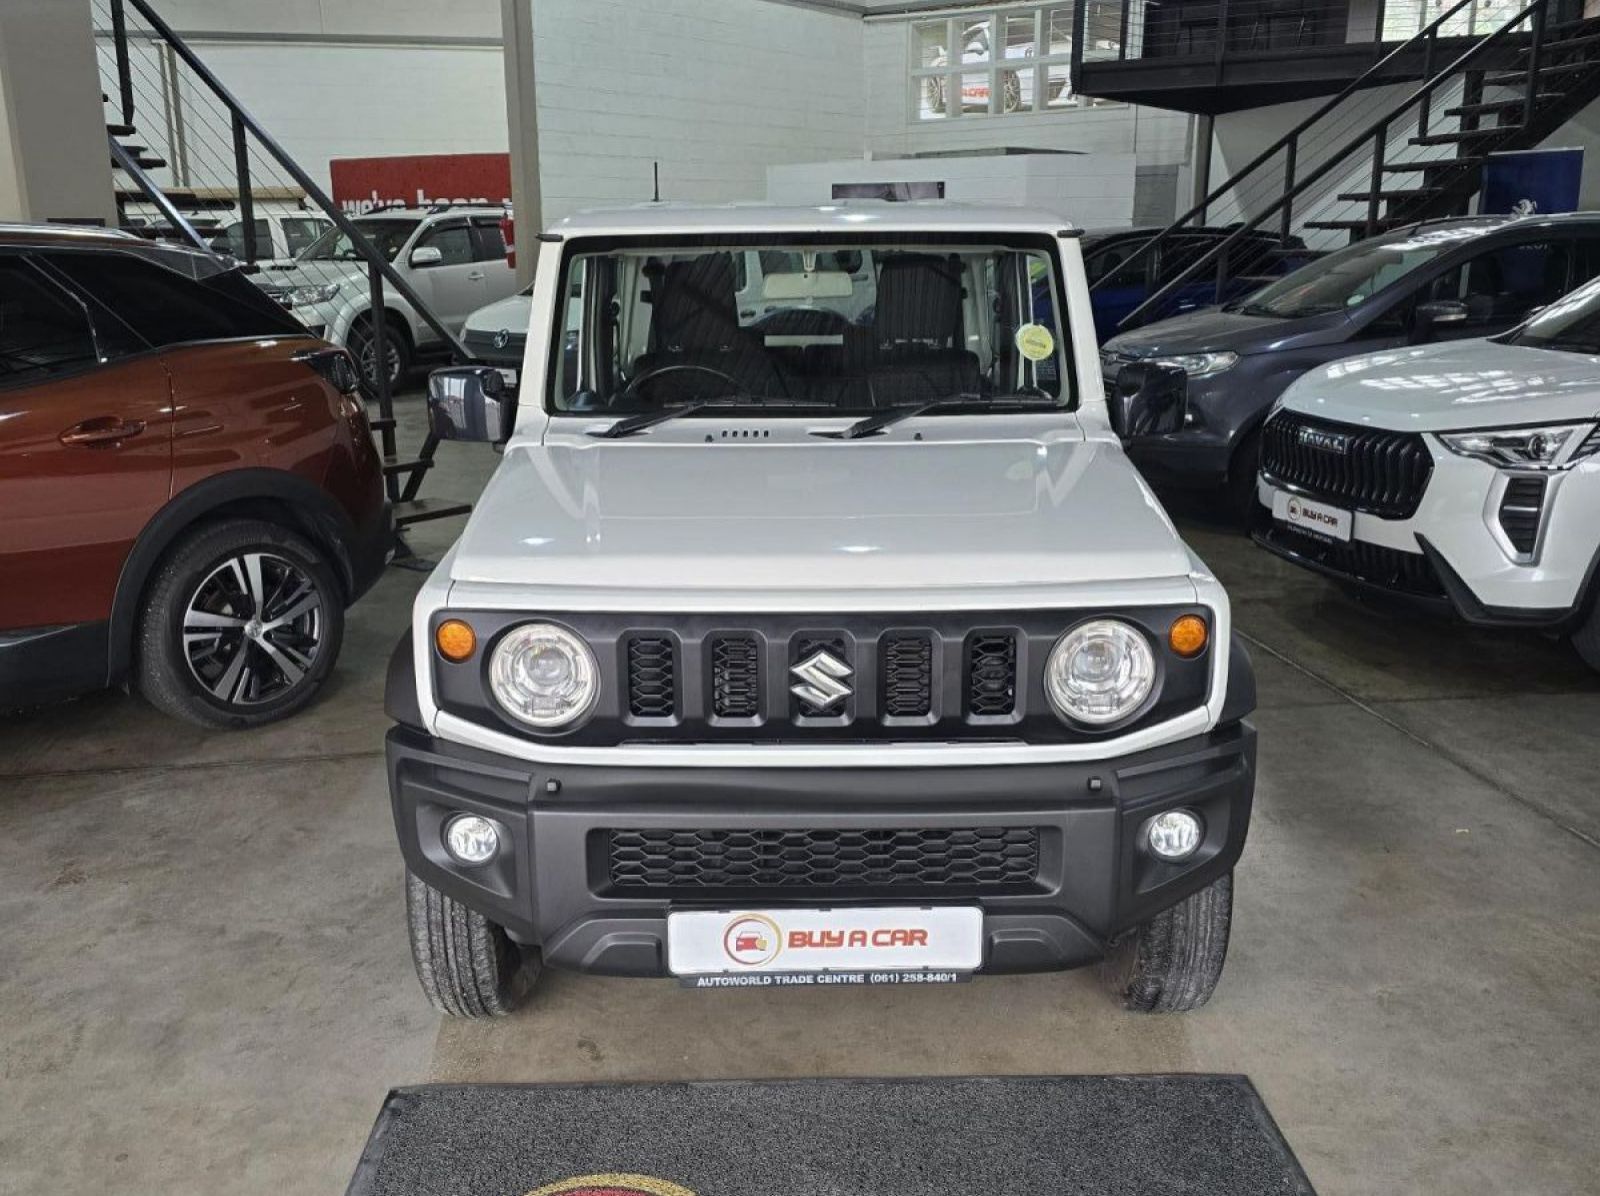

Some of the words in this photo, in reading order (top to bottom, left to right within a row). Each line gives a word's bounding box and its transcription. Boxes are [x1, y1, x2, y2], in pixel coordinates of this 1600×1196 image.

[788, 930, 845, 948] BUY
[847, 930, 868, 947] A
[871, 929, 929, 947] CAR
[697, 976, 772, 987] AUTOWORLD
[774, 975, 815, 984] TRADE
[816, 974, 865, 984] CENTRE
[870, 972, 899, 983] (061)
